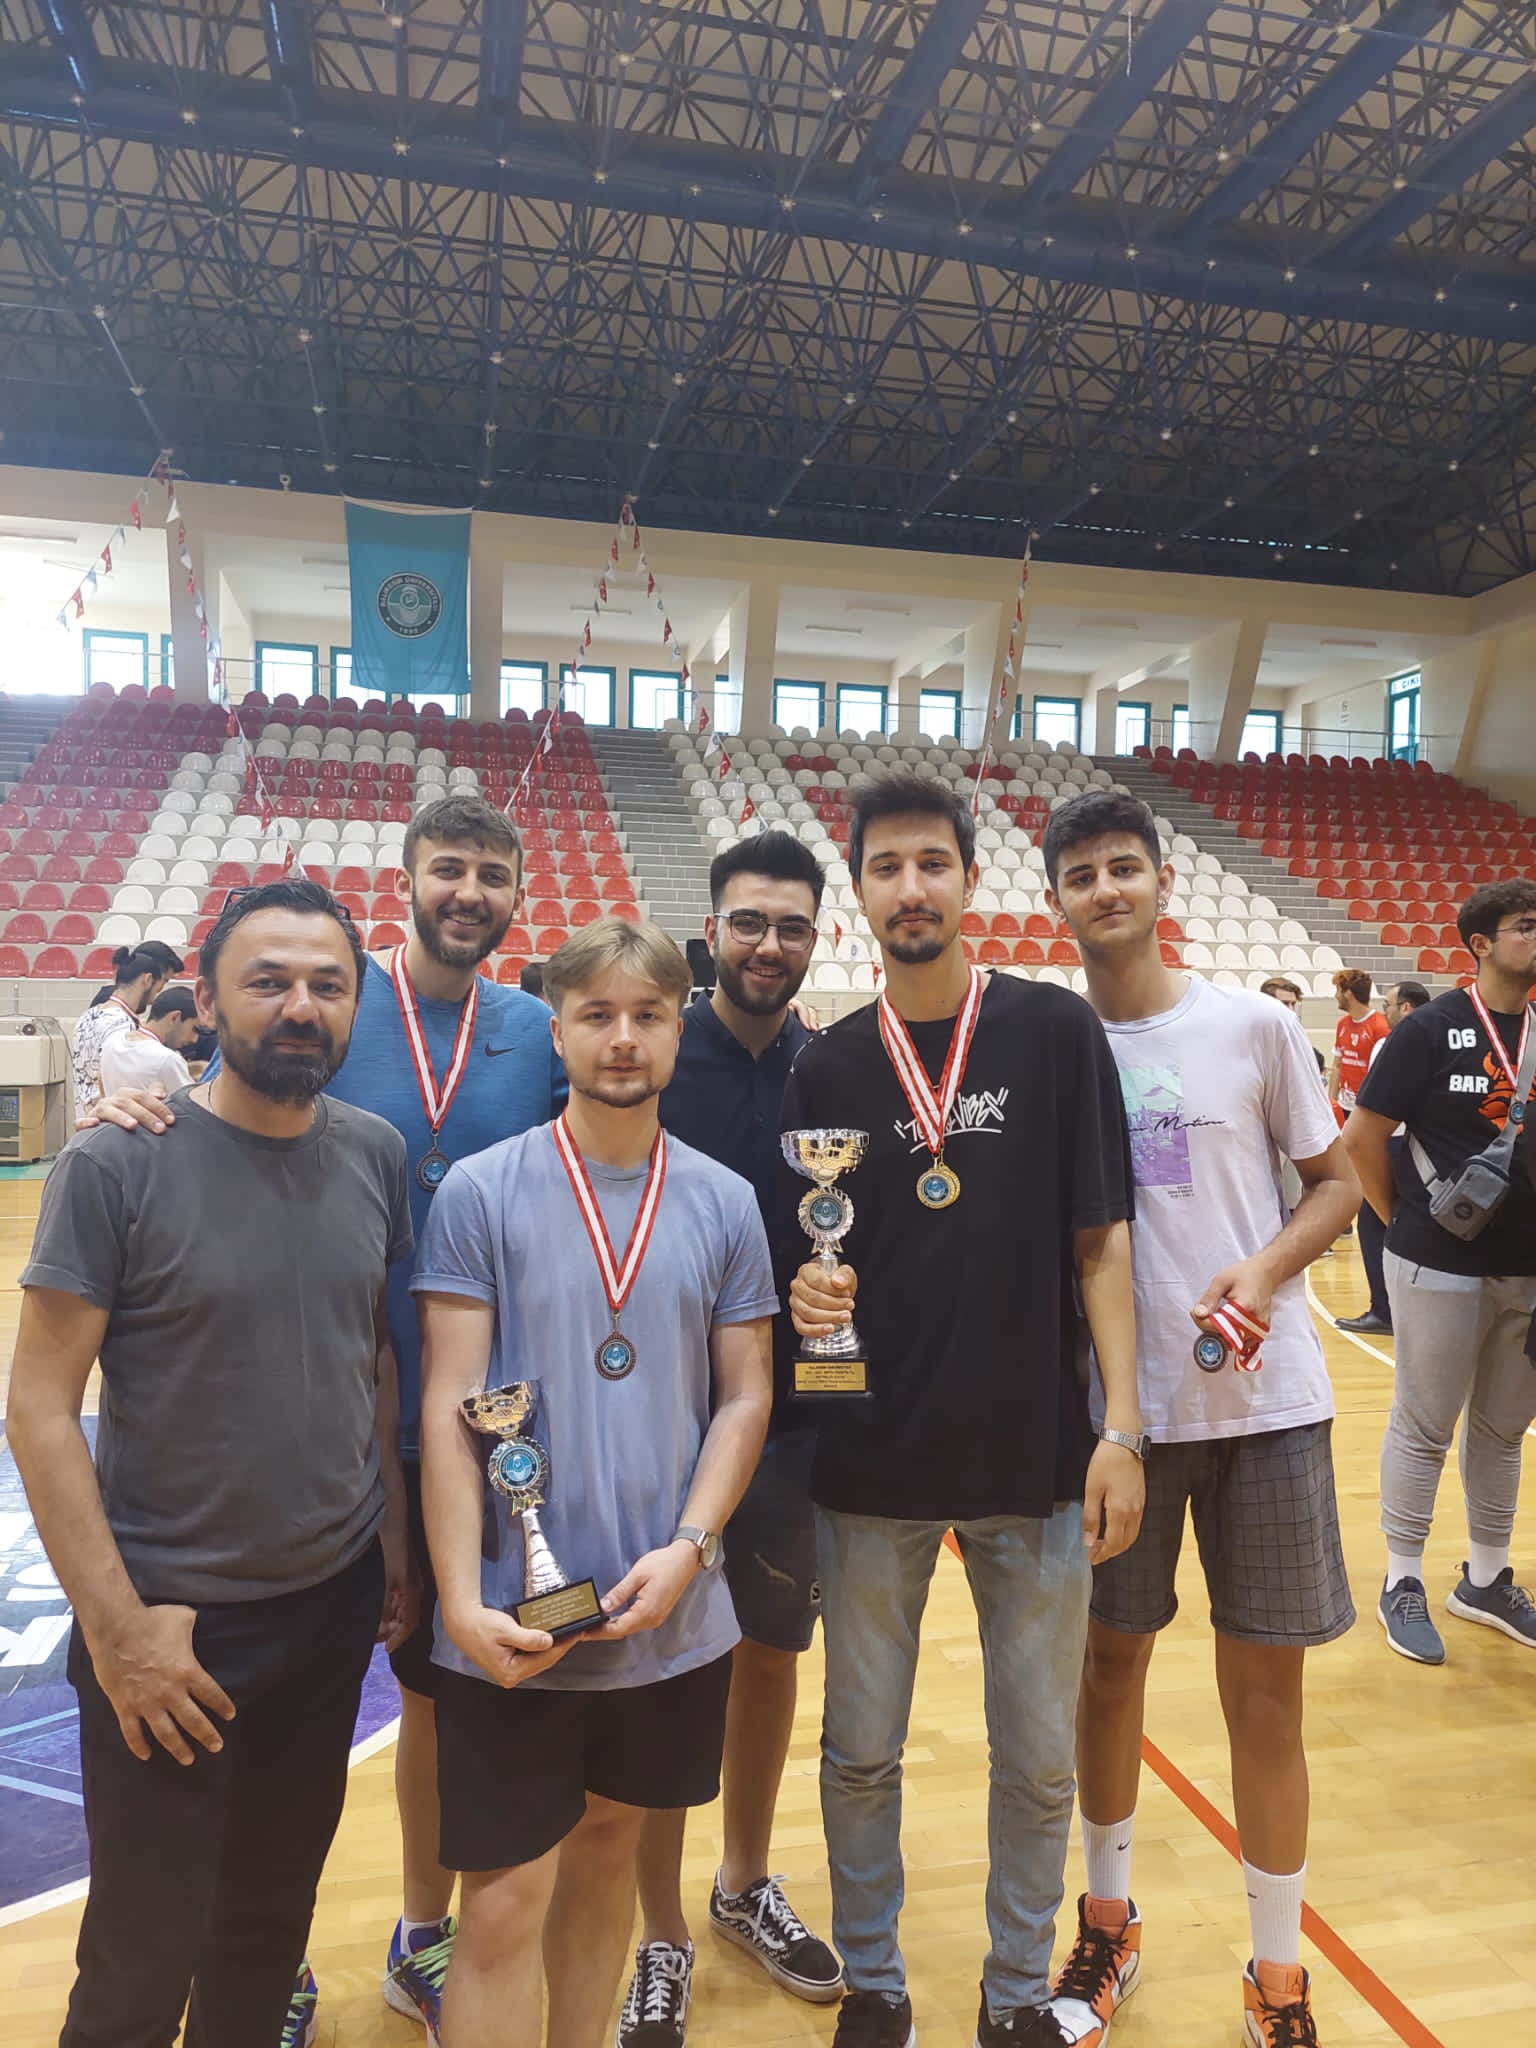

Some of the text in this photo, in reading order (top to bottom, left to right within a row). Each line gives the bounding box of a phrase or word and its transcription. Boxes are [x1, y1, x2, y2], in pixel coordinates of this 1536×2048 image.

[1448, 1028, 1477, 1050] 06
[1448, 1074, 1489, 1094] BAR
[1153, 1114, 1227, 1132] Motion
